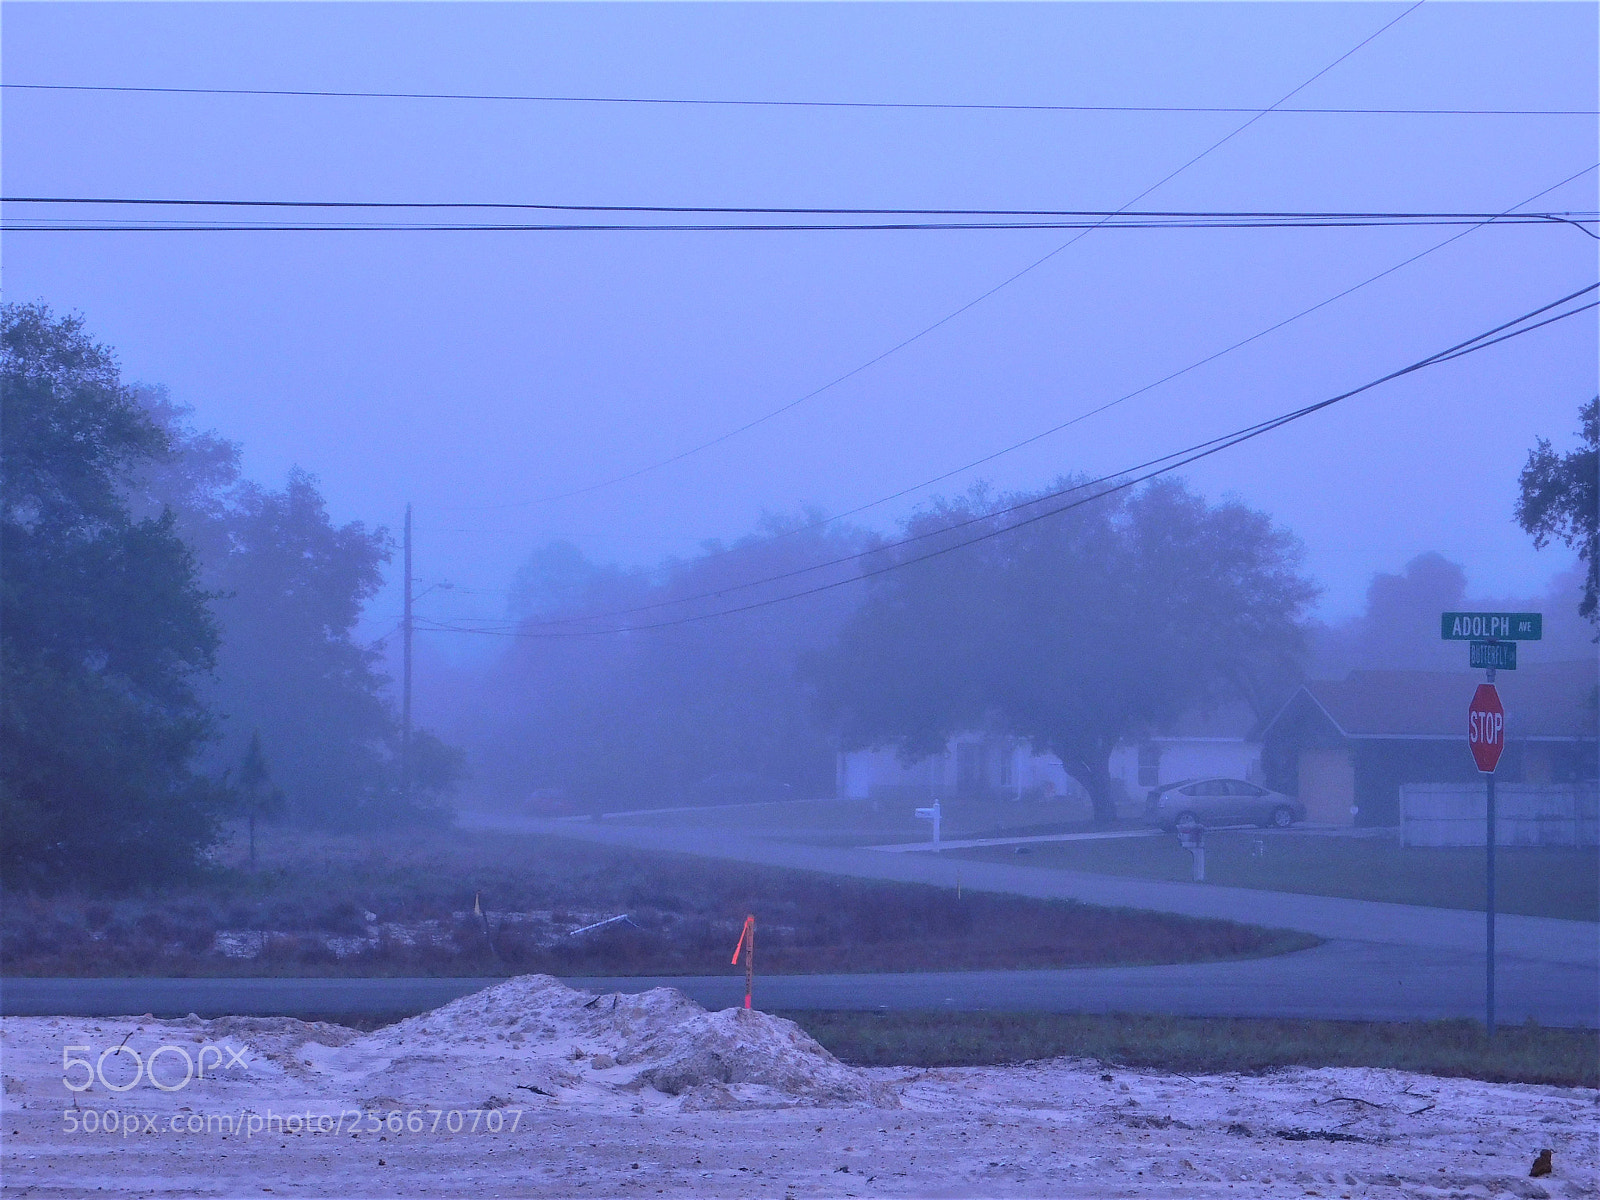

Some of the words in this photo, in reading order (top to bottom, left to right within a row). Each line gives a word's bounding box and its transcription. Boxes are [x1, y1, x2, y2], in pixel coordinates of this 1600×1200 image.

[1452, 616, 1510, 636] ADOLPH
[1518, 621, 1532, 632] AVE
[1471, 644, 1508, 665] BUTTERFLY
[1470, 710, 1503, 745] STOP
